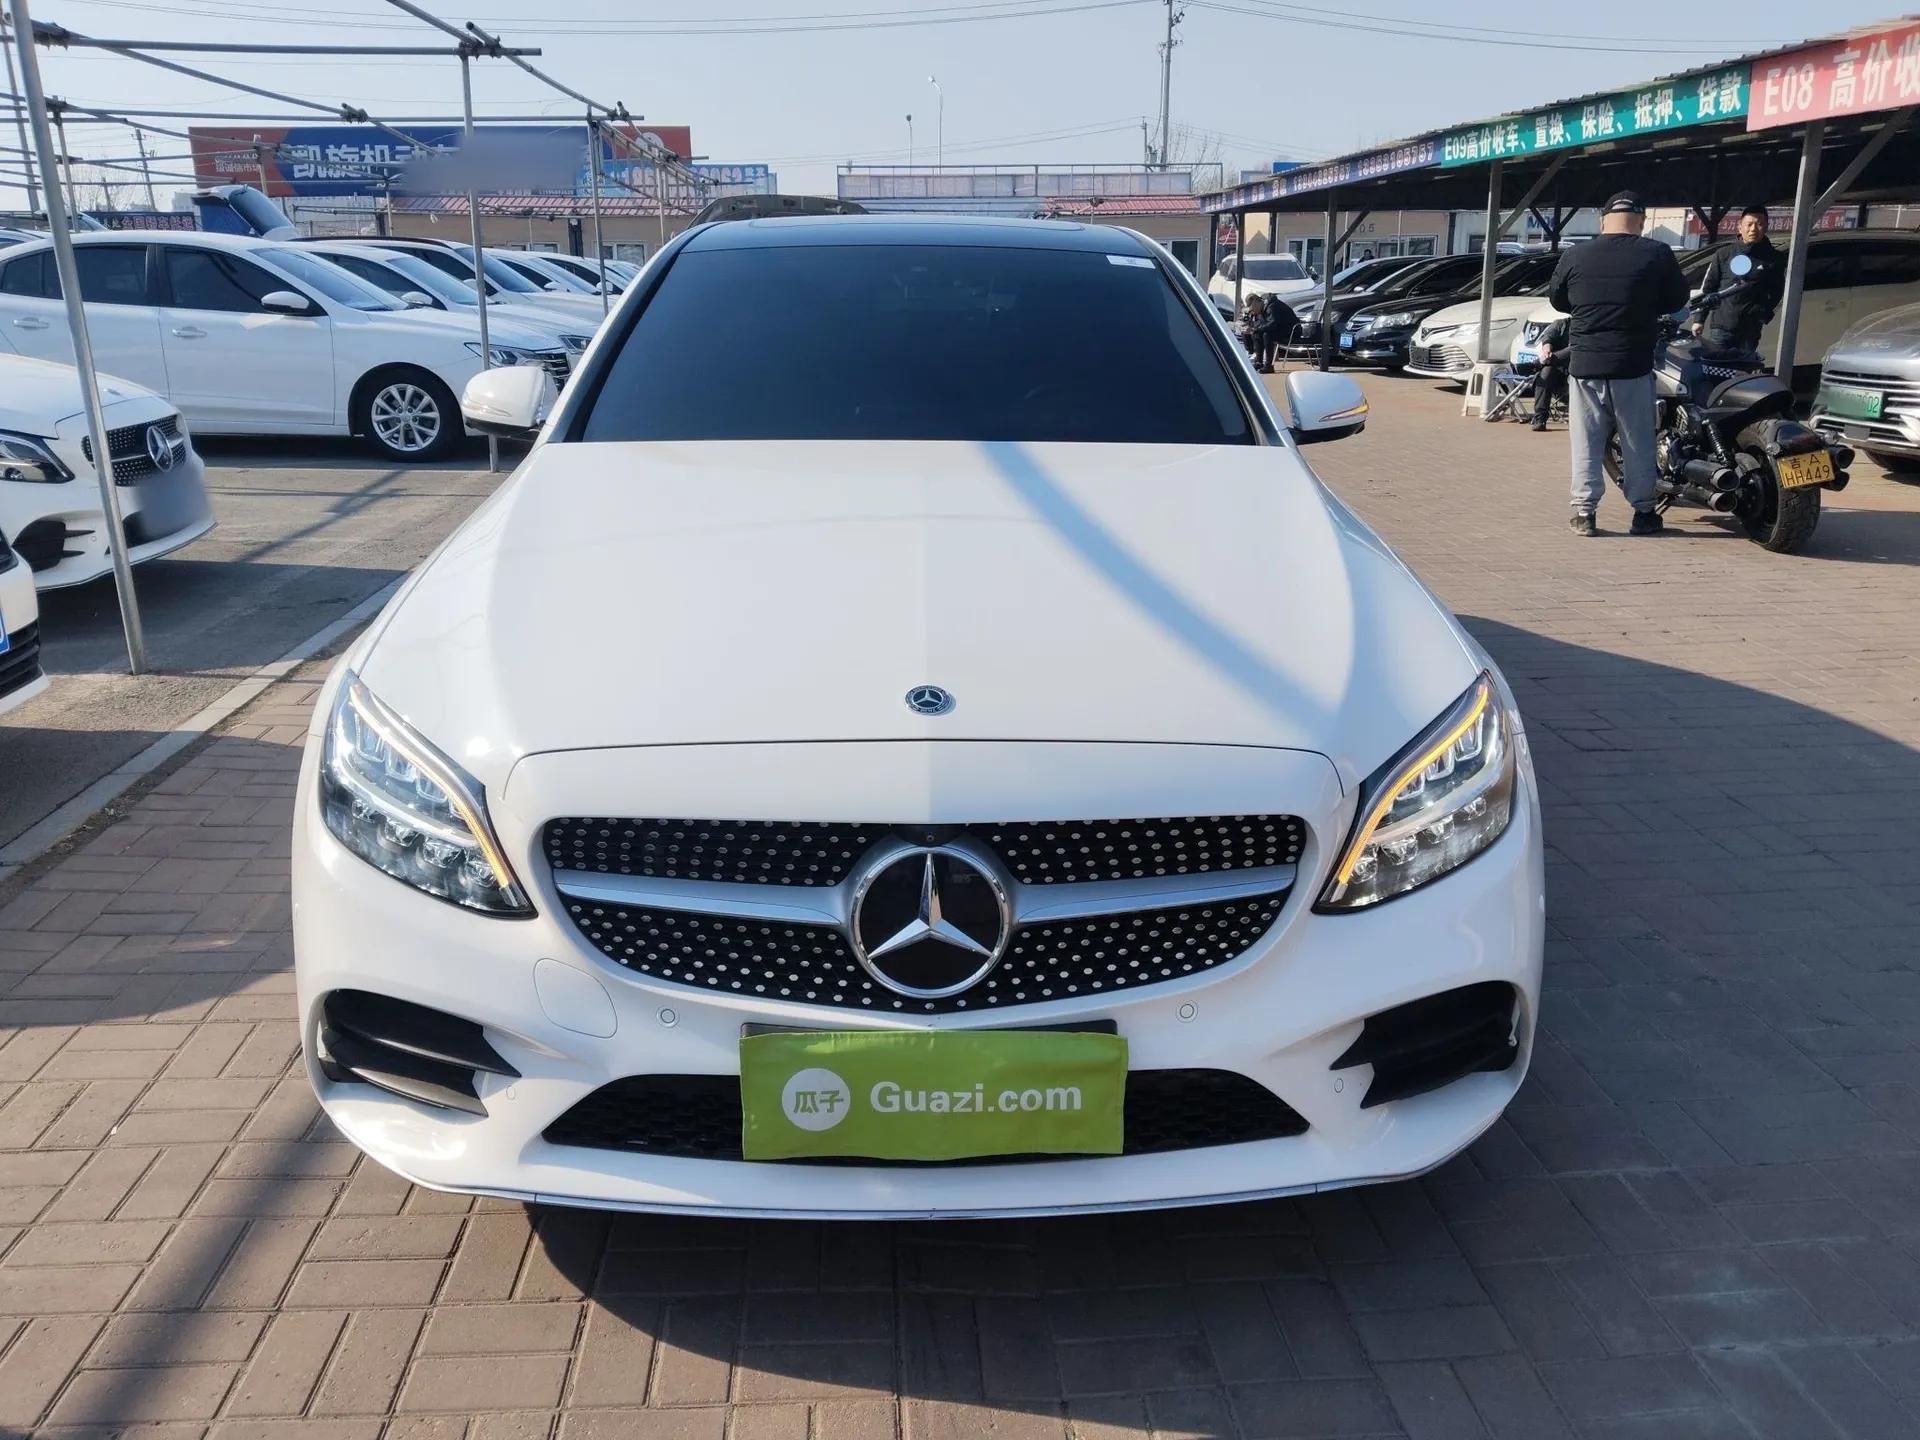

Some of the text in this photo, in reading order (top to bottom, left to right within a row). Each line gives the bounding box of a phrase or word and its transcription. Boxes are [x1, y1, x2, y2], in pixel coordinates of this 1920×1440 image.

[1763, 63, 1815, 116] E08
[793, 1081, 1083, 1115] 瓜子 Guazi.com
